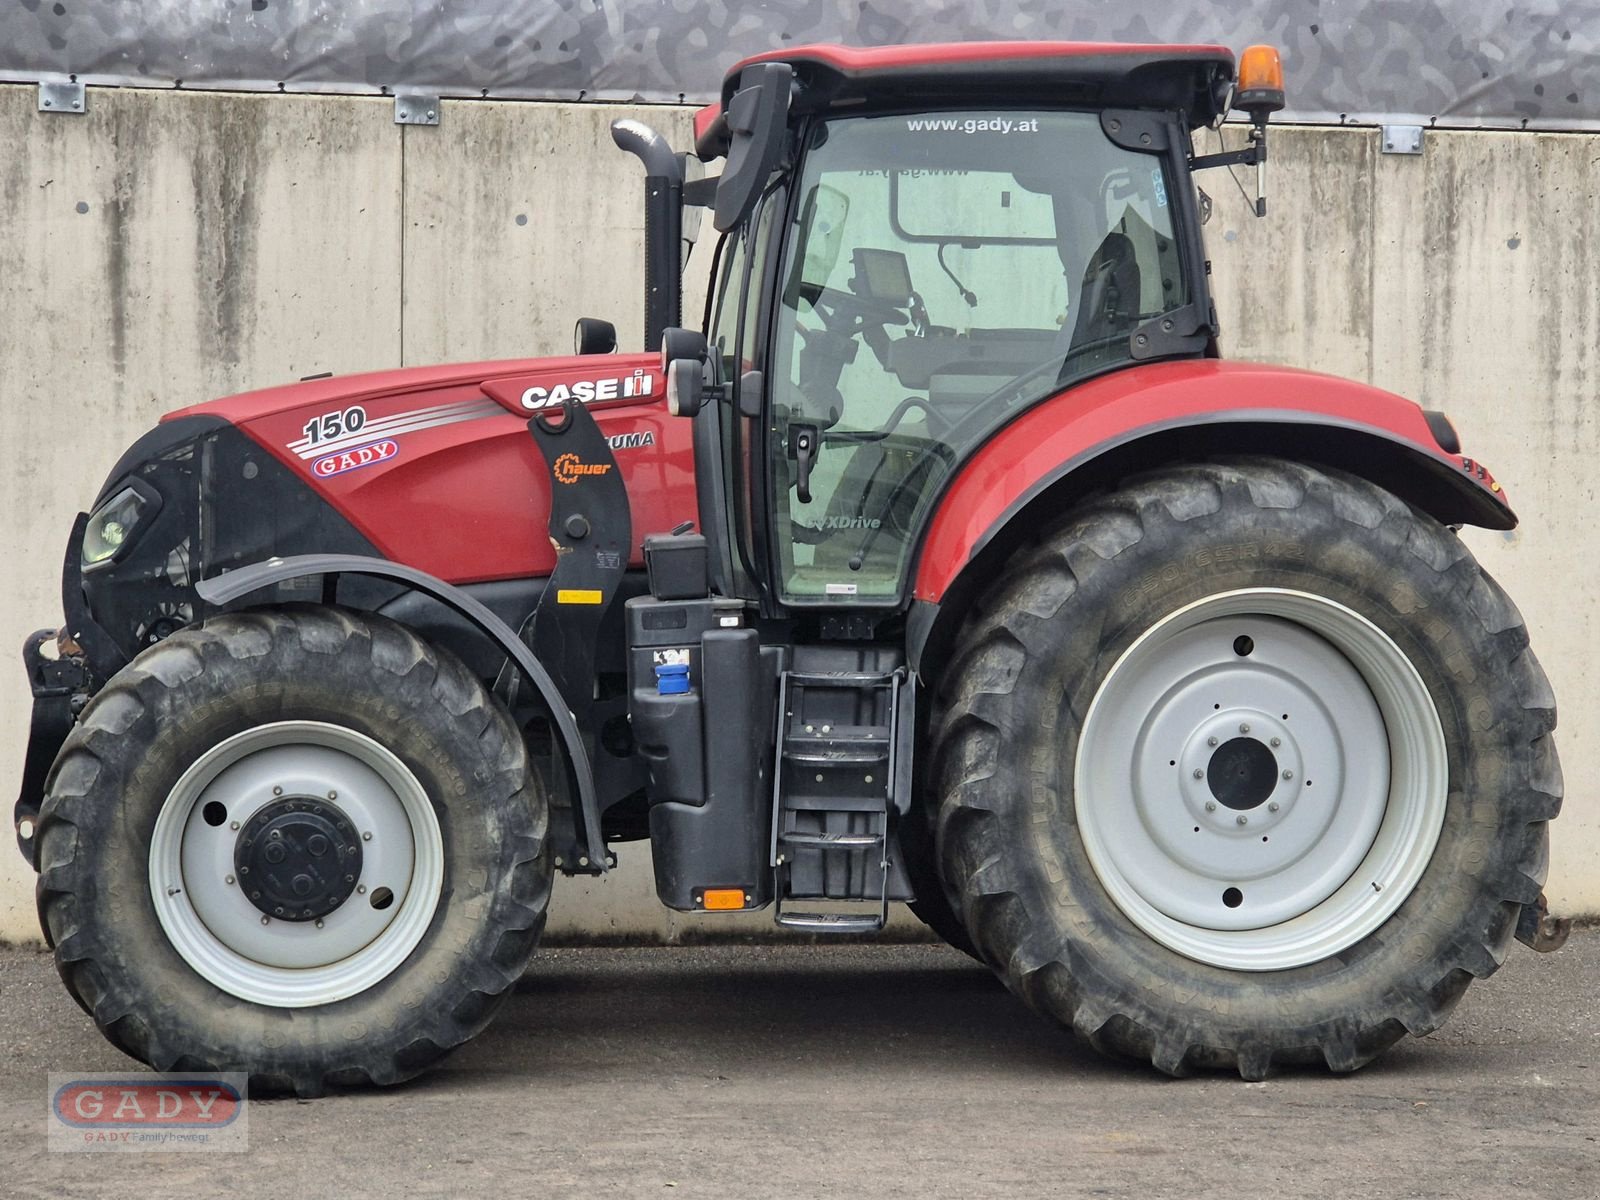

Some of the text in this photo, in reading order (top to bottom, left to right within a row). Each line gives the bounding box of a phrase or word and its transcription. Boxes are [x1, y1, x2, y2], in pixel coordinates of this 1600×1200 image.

[907, 117, 1039, 134] www.gady.at
[521, 381, 618, 409] CASE
[303, 406, 366, 445] 150
[605, 431, 655, 450] UMA
[320, 442, 389, 474] GADY
[563, 460, 611, 475] hauer
